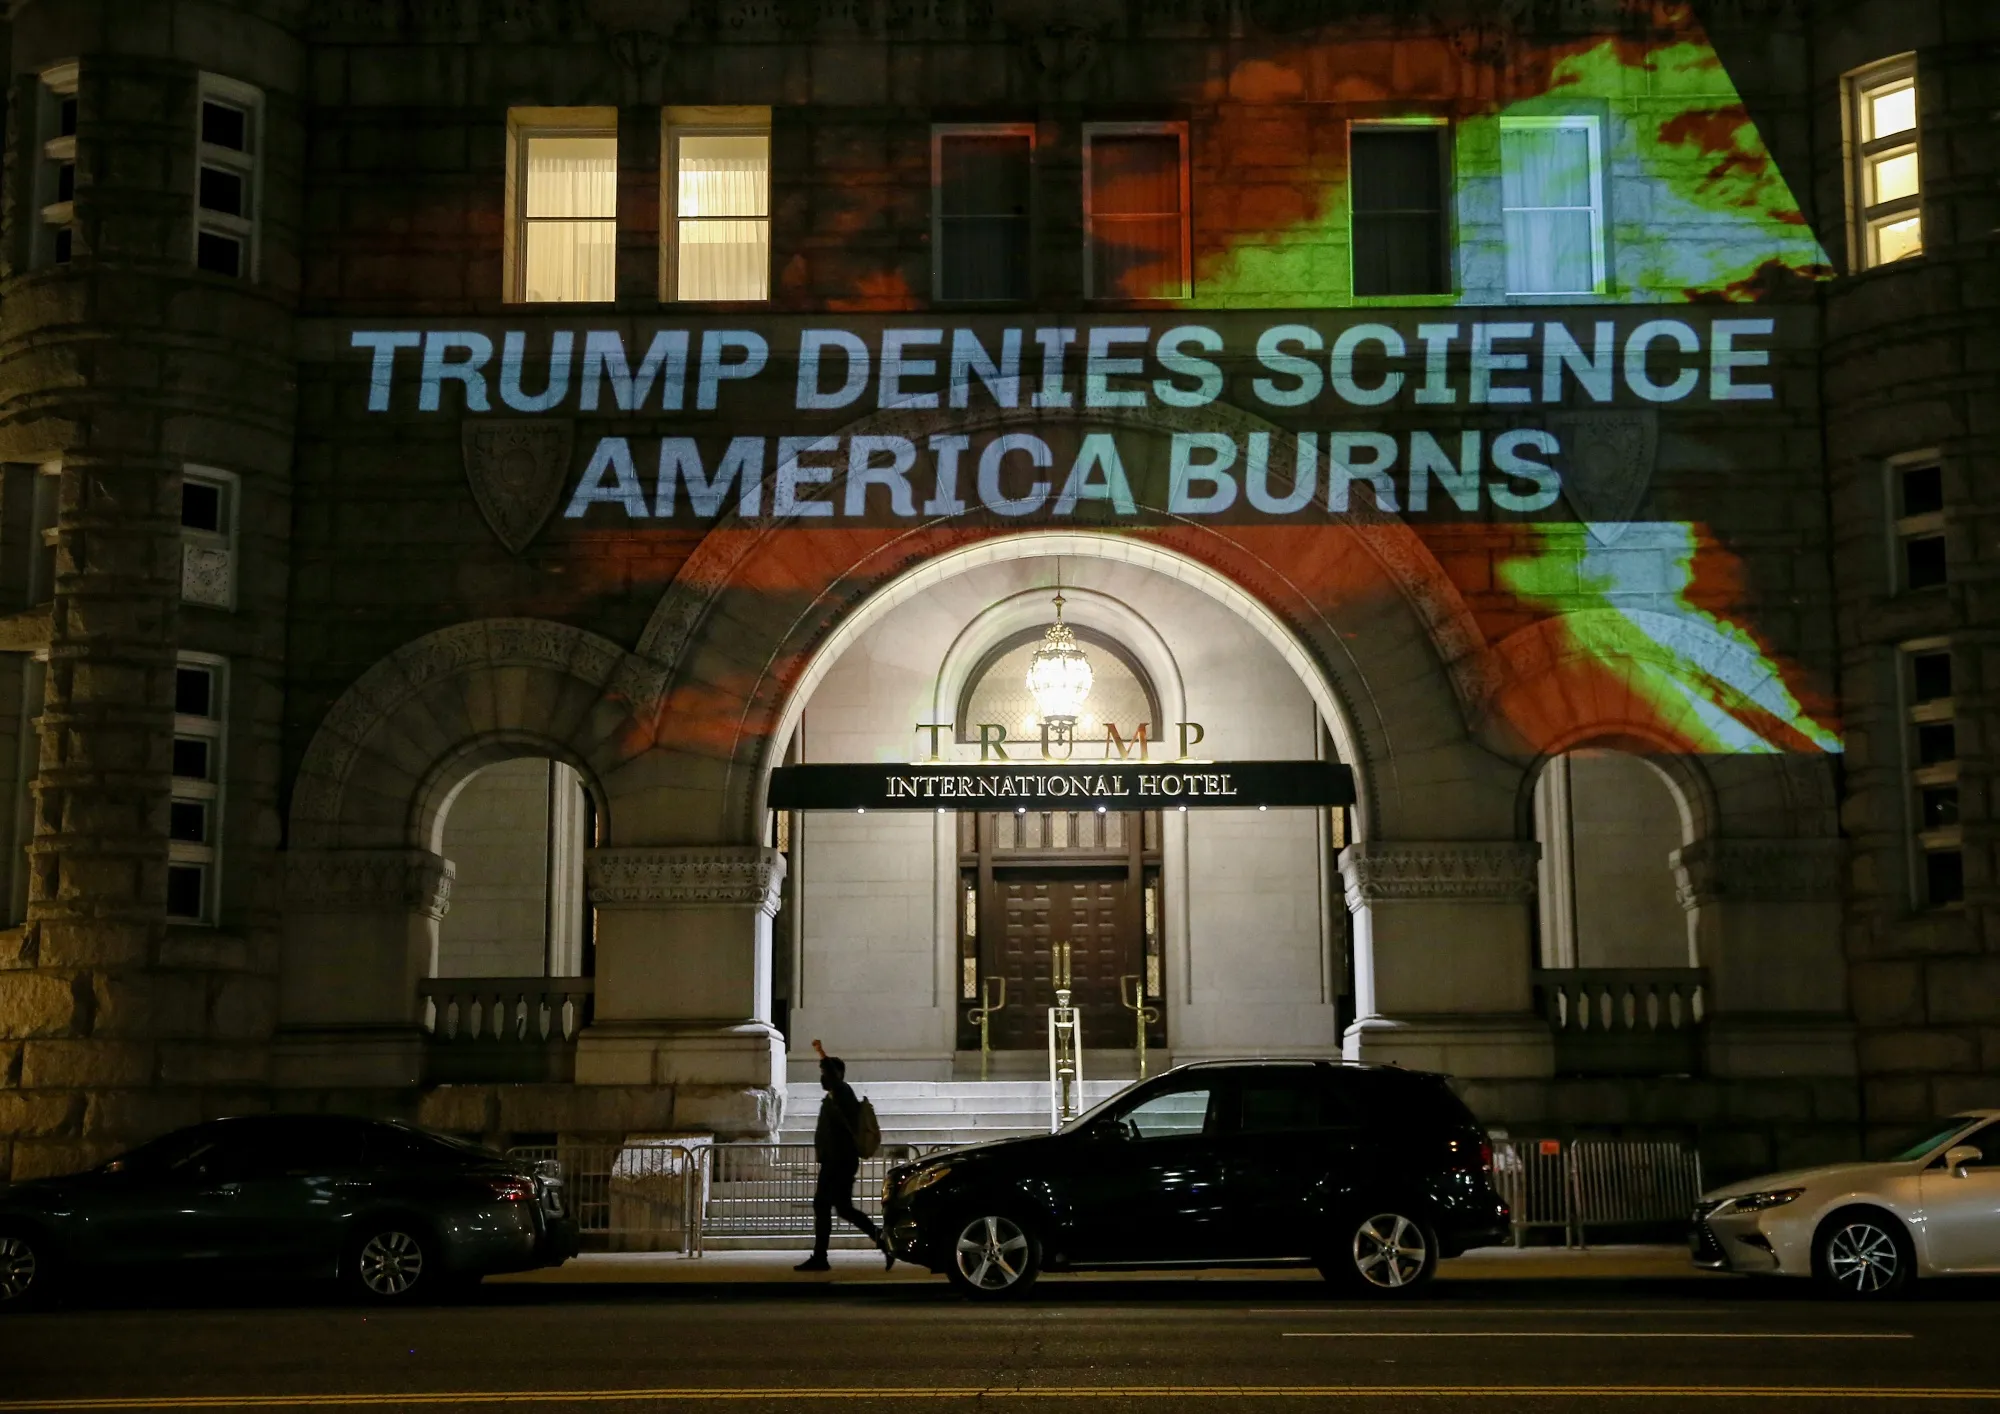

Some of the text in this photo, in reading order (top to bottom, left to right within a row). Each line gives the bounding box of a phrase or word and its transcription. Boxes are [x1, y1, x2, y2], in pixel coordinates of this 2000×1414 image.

[350, 318, 1775, 413] TRUMP DENIES SCIENCE
[563, 428, 1562, 519] AMERICA BURNS
[915, 722, 1205, 762] TRUMP
[885, 773, 1238, 798] INTERNATIONAL HOTEL
